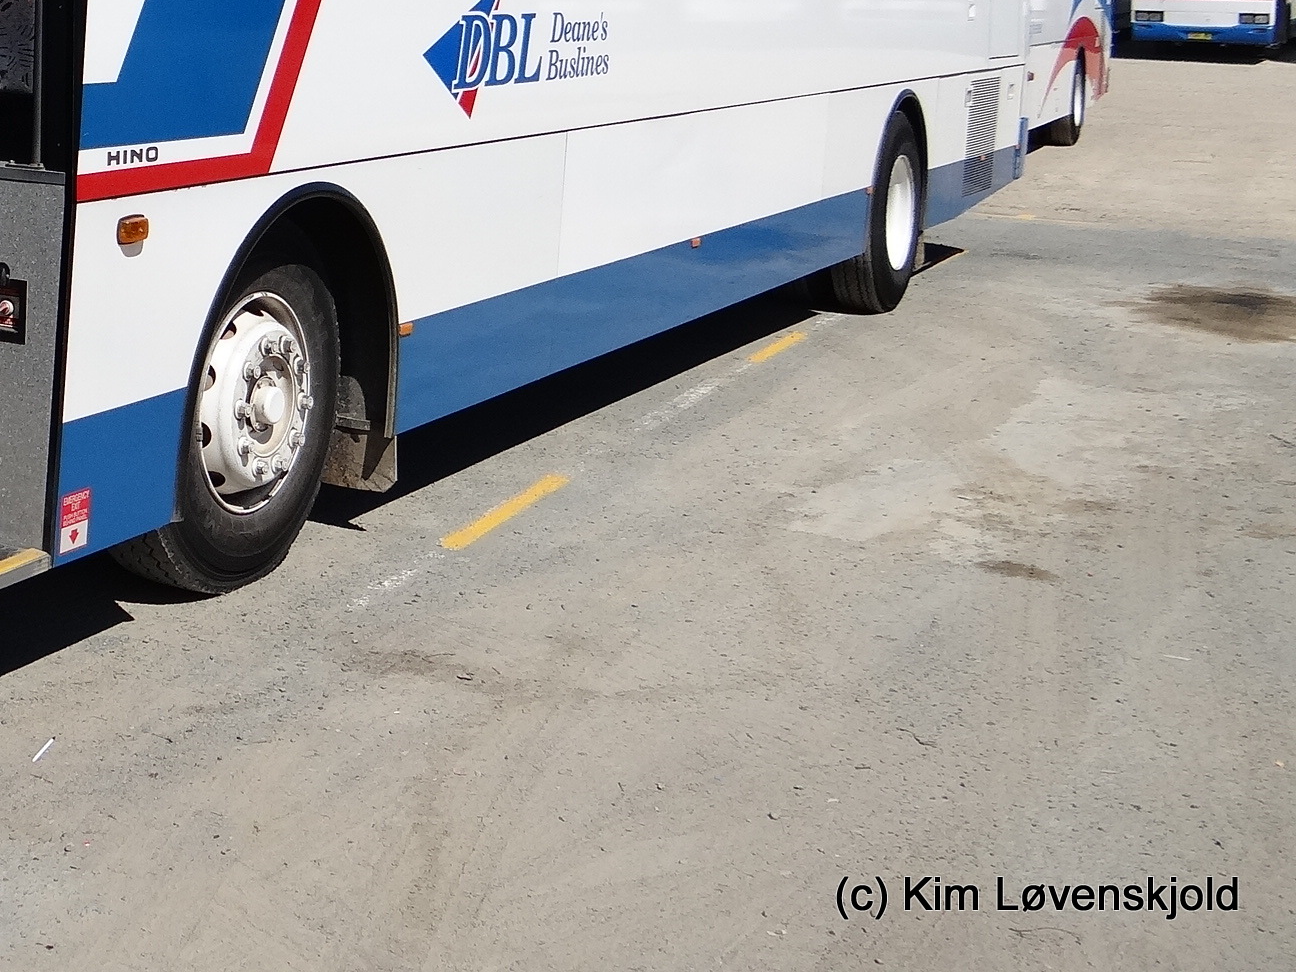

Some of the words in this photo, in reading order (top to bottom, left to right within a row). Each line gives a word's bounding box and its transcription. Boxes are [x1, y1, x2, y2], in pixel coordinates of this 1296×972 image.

[454, 13, 542, 90] DBL
[550, 12, 608, 43] Deane's
[546, 46, 609, 81] Buslines
[107, 147, 159, 166] HINO
[63, 489, 90, 506] EMERGENCY
